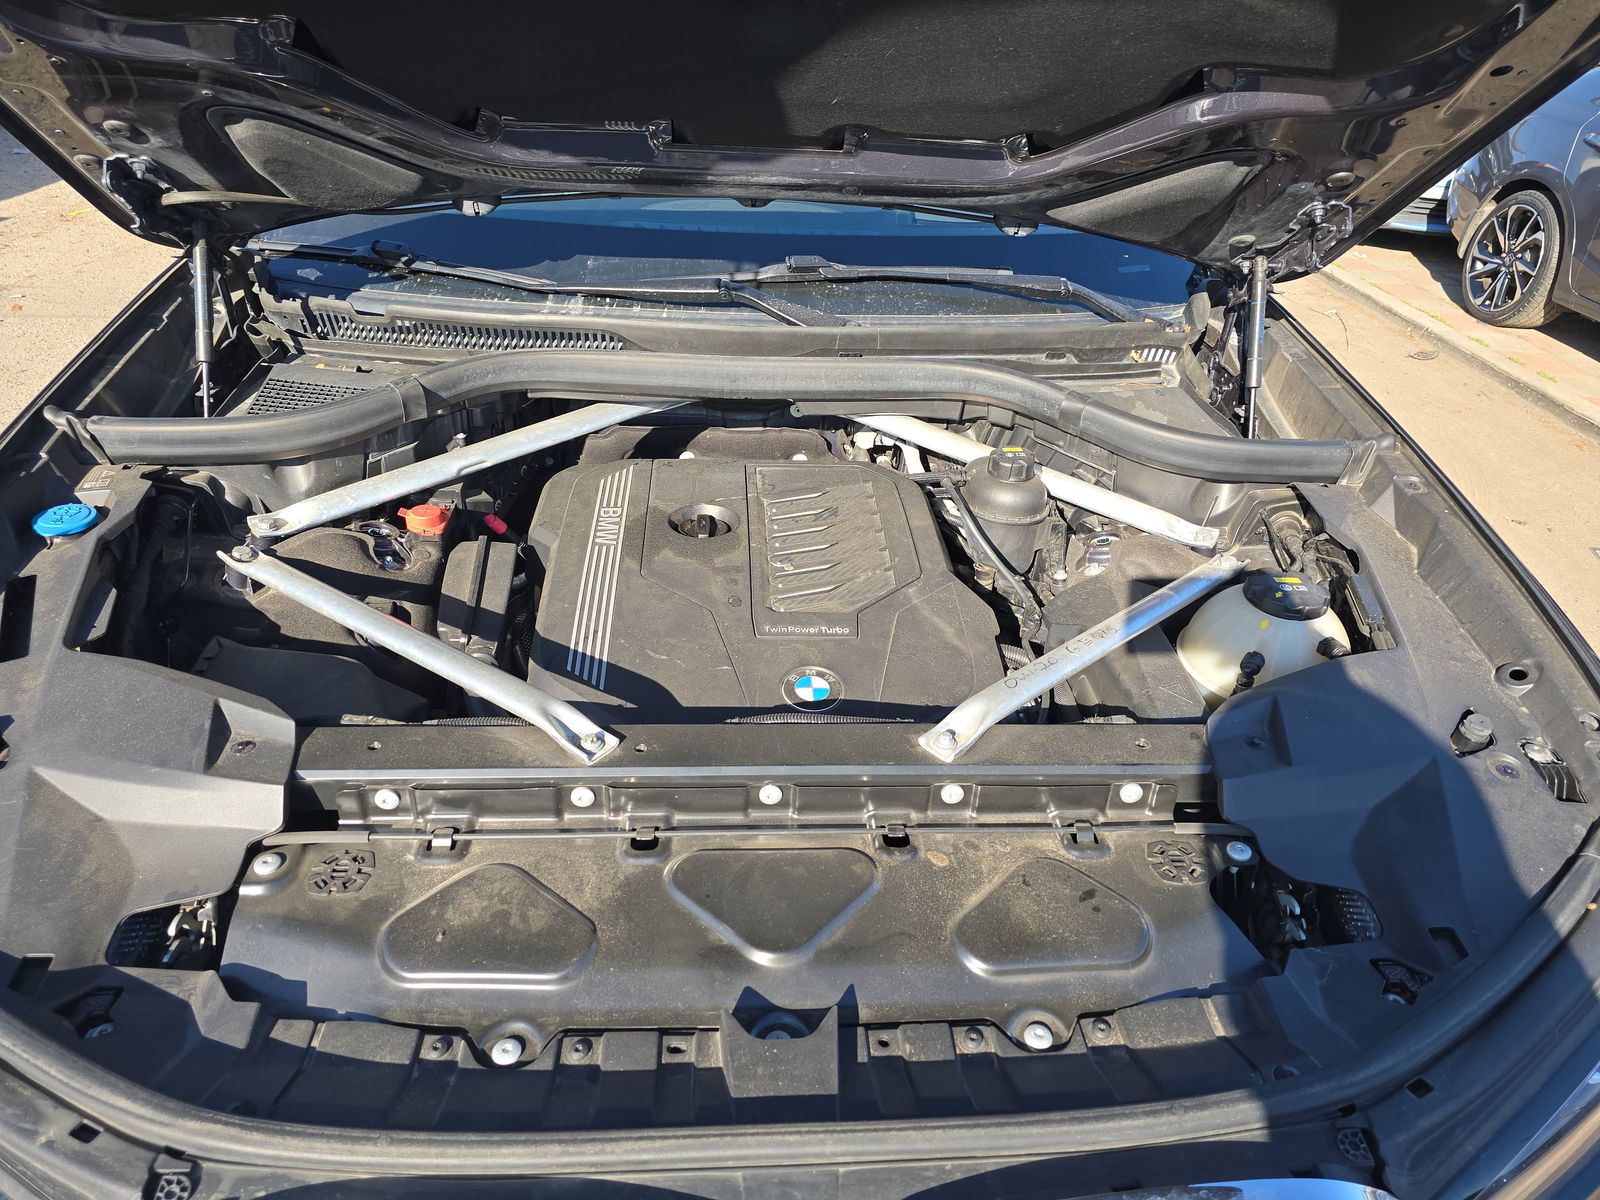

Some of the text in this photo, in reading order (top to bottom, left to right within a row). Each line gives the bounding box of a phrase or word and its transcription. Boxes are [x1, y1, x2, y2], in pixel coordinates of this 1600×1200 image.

[595, 507, 622, 545] BMW
[763, 625, 850, 634] TwinPower Turbo
